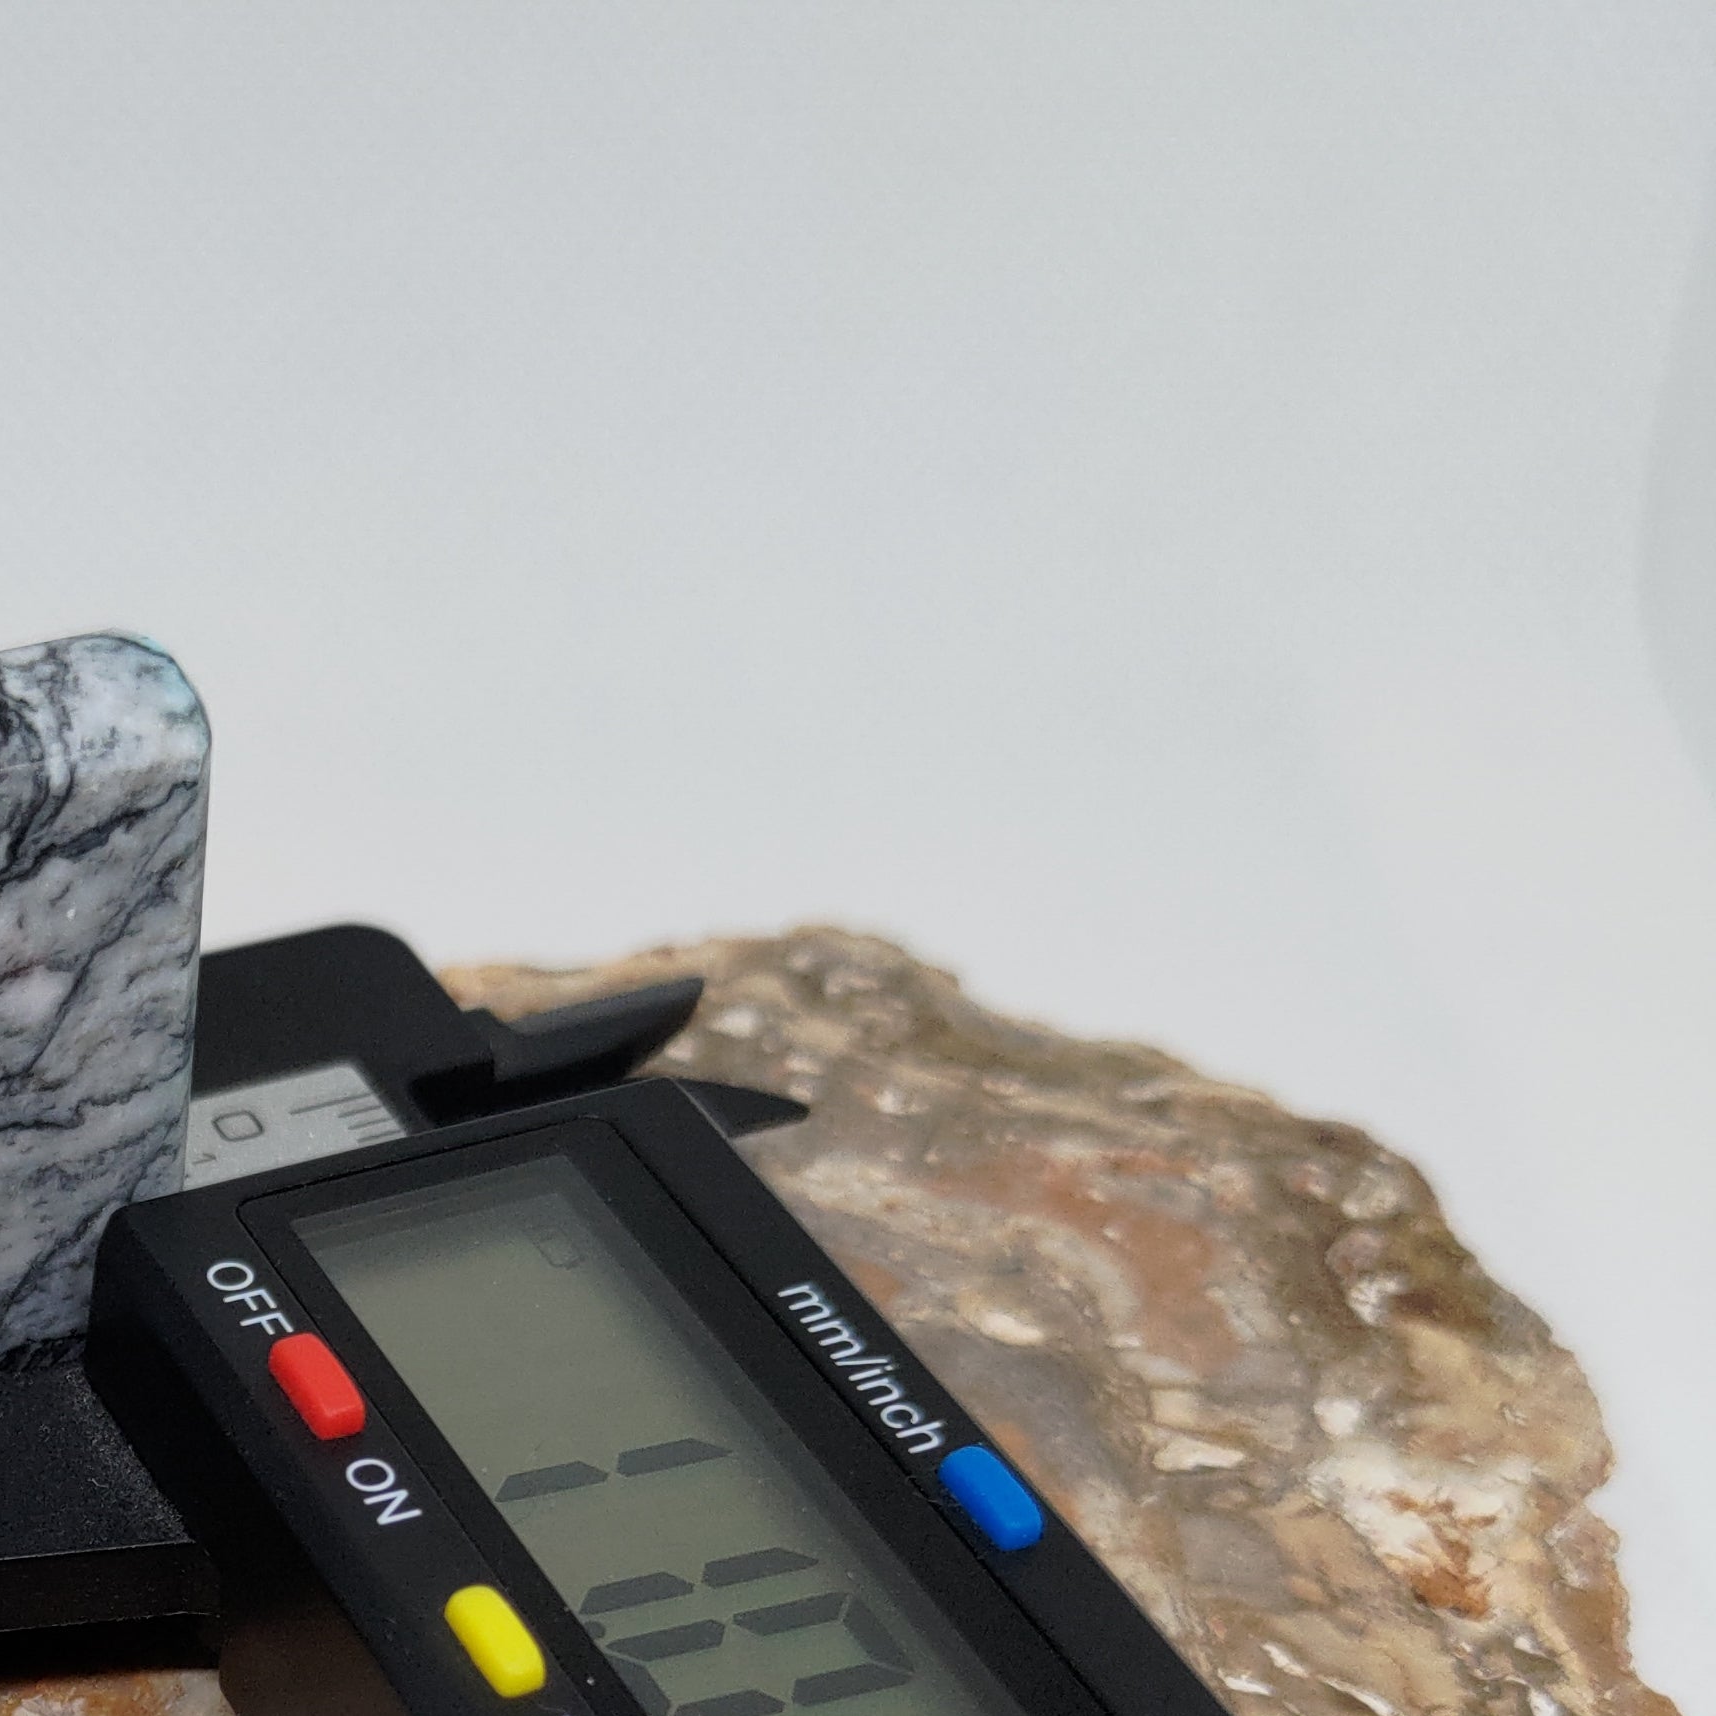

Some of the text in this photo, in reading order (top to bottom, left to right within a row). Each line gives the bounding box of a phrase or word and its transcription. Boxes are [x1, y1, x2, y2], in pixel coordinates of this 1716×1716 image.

[205, 1261, 295, 1337] OFF
[775, 1281, 949, 1457] mm/inch
[344, 1457, 424, 1526] ON
